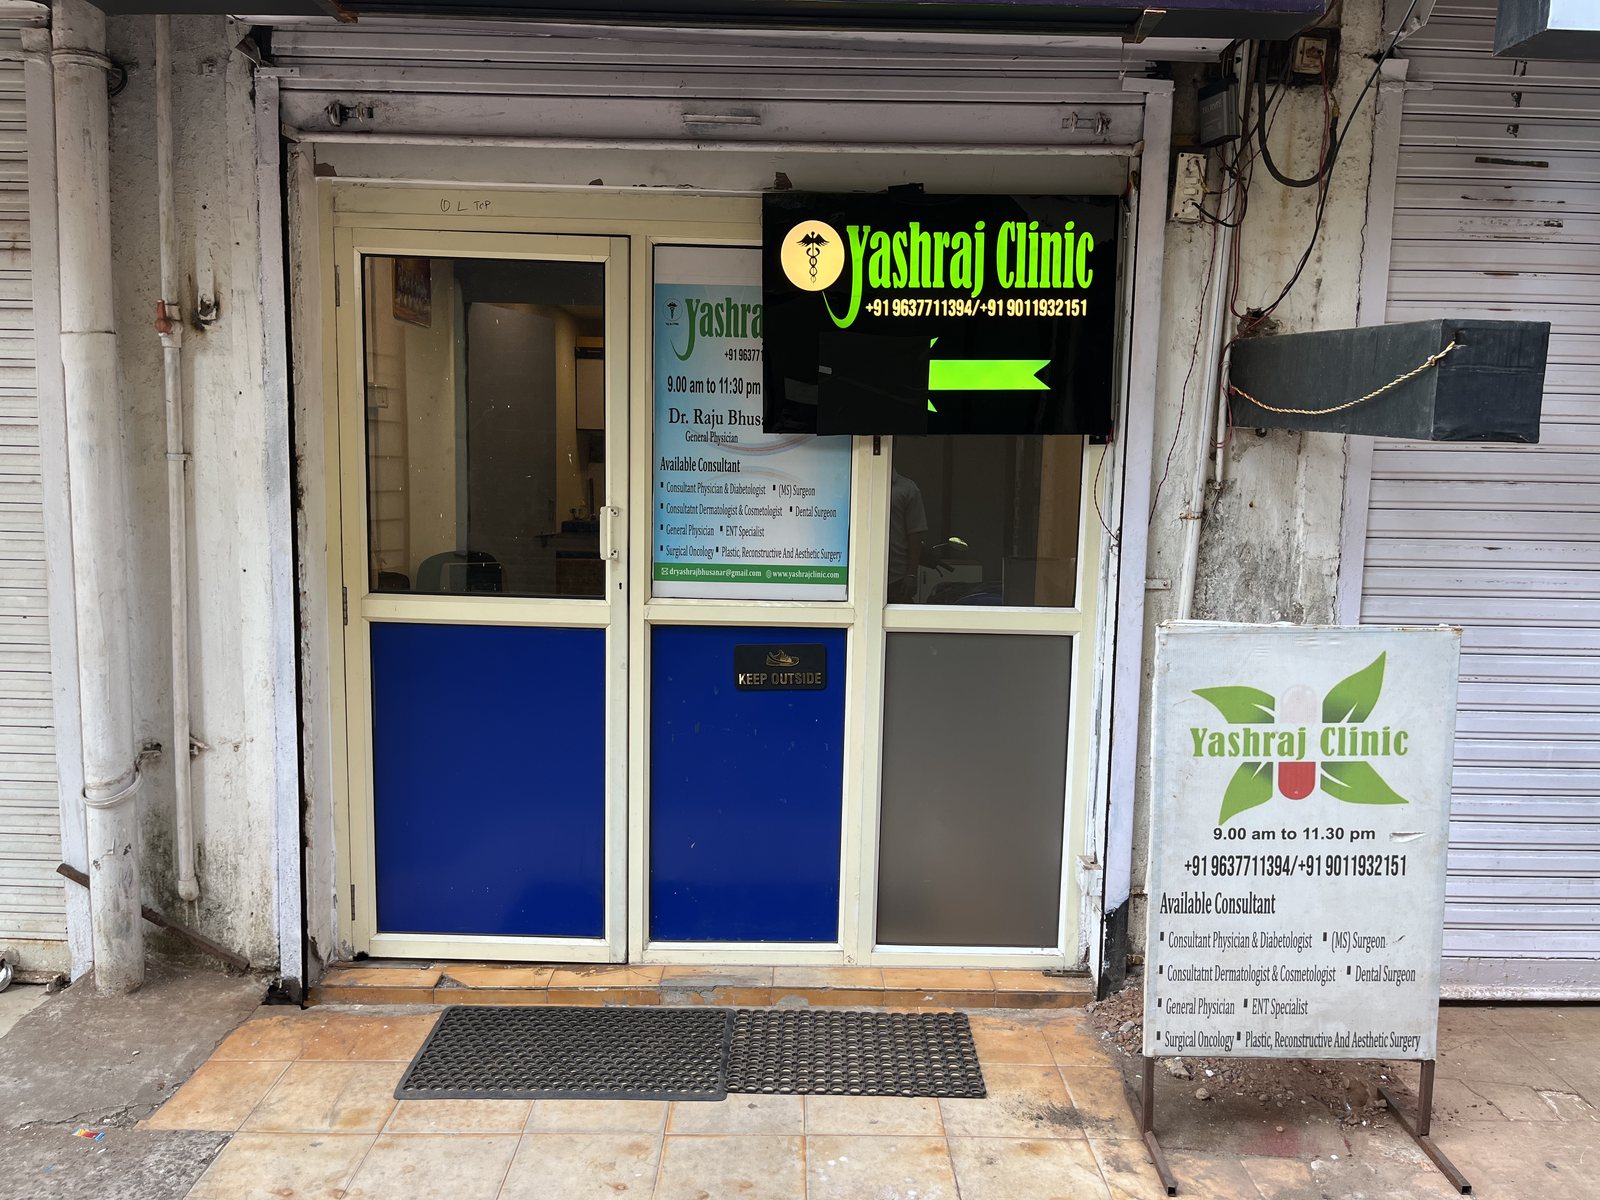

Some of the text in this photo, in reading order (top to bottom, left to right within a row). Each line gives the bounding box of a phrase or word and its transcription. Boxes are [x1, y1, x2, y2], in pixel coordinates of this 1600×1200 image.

[996, 220, 1093, 290] Clinic
[1006, 299, 1087, 317] 9011932151
[670, 297, 763, 361] Yashra
[667, 376, 761, 399] 9.00 am to 11:30 pm
[668, 407, 689, 424] Dr.
[694, 408, 724, 430] Raju
[685, 430, 739, 447] General Physician
[660, 456, 741, 473] Available Consultant
[666, 482, 816, 499] Consultant Physician & Diabetologist (MS) Surgeon
[699, 504, 738, 519] Dermatologist
[738, 505, 744, 516] &
[744, 505, 783, 519] Cosmetologist
[795, 506, 814, 518] Dental
[814, 506, 837, 520] Surgeon
[666, 524, 765, 540] General Physician ENT Specialist
[665, 545, 842, 563] Surgical Oncology Plastic, Reconstructive And Aesthetic Surgery
[738, 672, 822, 685] KEEP OUTSIDE
[1190, 726, 1409, 761] Yashraj Clinic
[1213, 827, 1376, 843] 9.00 am to 11.30 pm
[1184, 854, 1210, 876] +91
[1325, 854, 1406, 876] 9011932151
[1160, 891, 1276, 915] Available Consultant
[1168, 931, 1386, 954] Consultant Physician & Diabetologist (MS) Surgeon
[1167, 964, 1416, 987] Consultatnt Dermatologist & Cosmetologist Dental Surgeon
[1165, 998, 1308, 1019] General Physician ENT Specialist
[1165, 1031, 1421, 1052] Surgical Oncology Plastic, Reconstructive And Aesthetic Surgery
